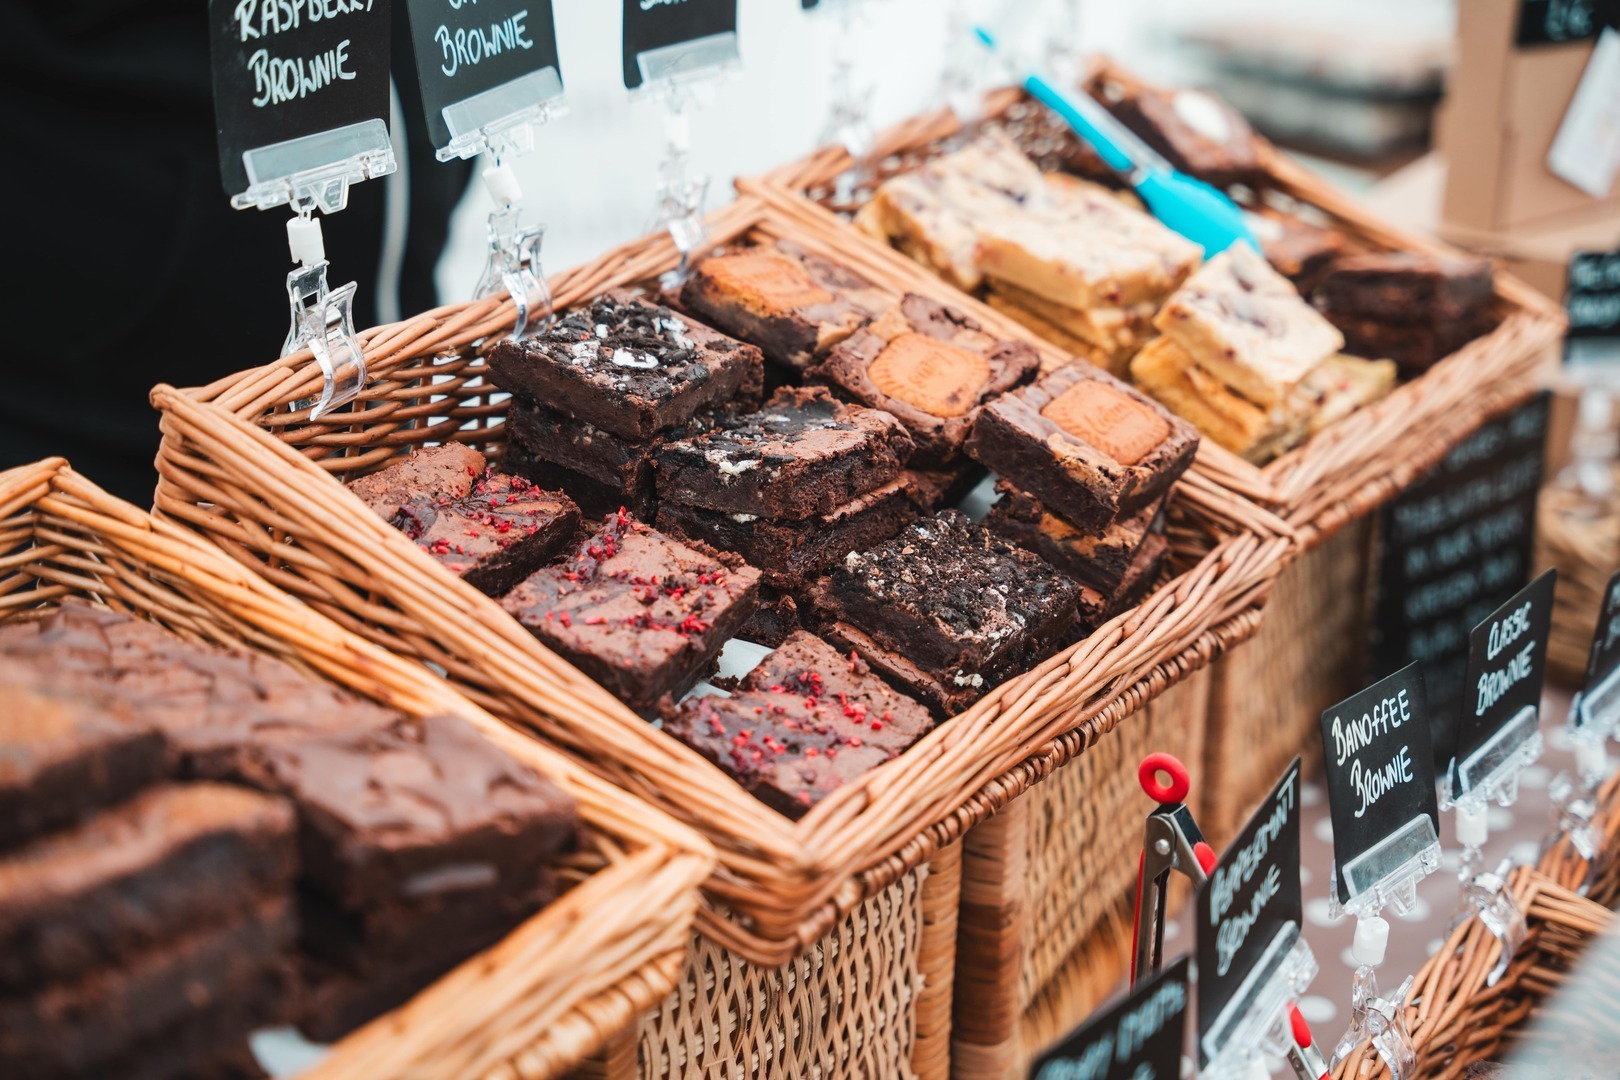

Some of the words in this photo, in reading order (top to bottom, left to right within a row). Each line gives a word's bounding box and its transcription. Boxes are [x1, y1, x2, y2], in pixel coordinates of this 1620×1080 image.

[247, 39, 357, 108] BROWNIE
[434, 9, 534, 78] BROWNIE
[1487, 601, 1532, 661] CLASSIC
[1475, 640, 1537, 716] BROWNIE
[1331, 688, 1411, 767] BANOFFEE
[1350, 745, 1414, 818] BROWNIE
